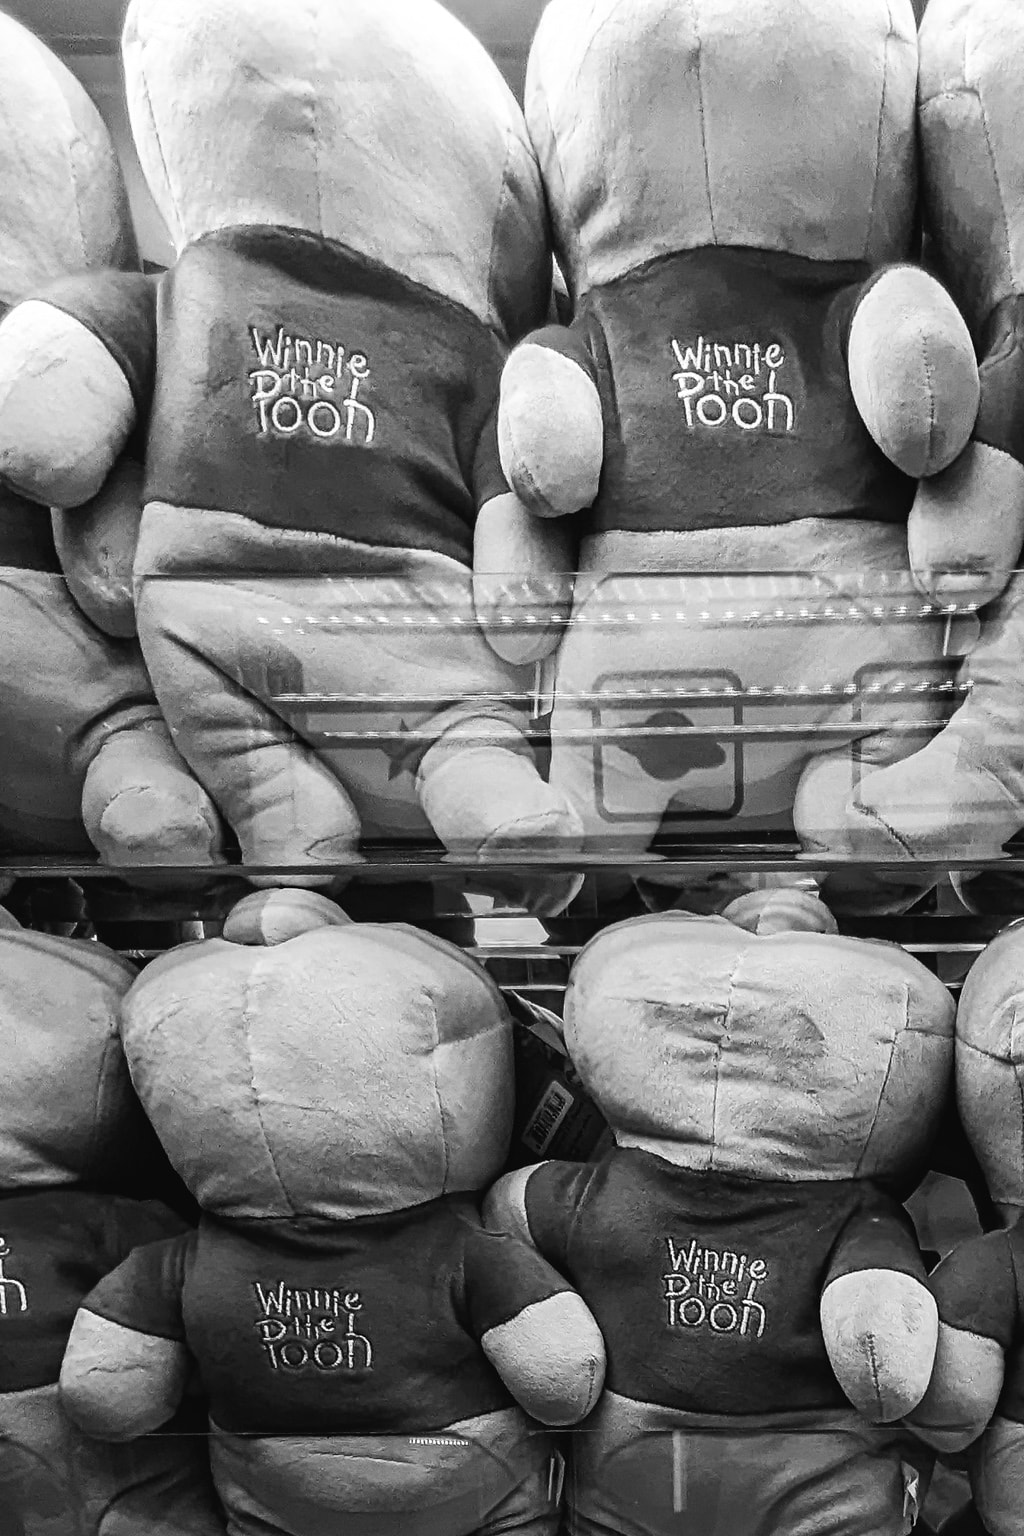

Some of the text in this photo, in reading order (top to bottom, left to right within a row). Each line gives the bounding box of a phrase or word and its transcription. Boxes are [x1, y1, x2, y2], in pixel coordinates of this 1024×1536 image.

[252, 328, 370, 378] Winnie
[671, 336, 784, 375] Winnie
[282, 366, 334, 400] the
[672, 370, 794, 431] Pooh
[706, 369, 756, 396] the
[250, 370, 375, 443] Pooh
[668, 1238, 769, 1281] Winnie
[256, 1281, 362, 1317] Winnie
[663, 1273, 766, 1338] Pooh
[698, 1273, 737, 1301] the
[255, 1313, 372, 1369] Pooh
[294, 1314, 335, 1340] the
